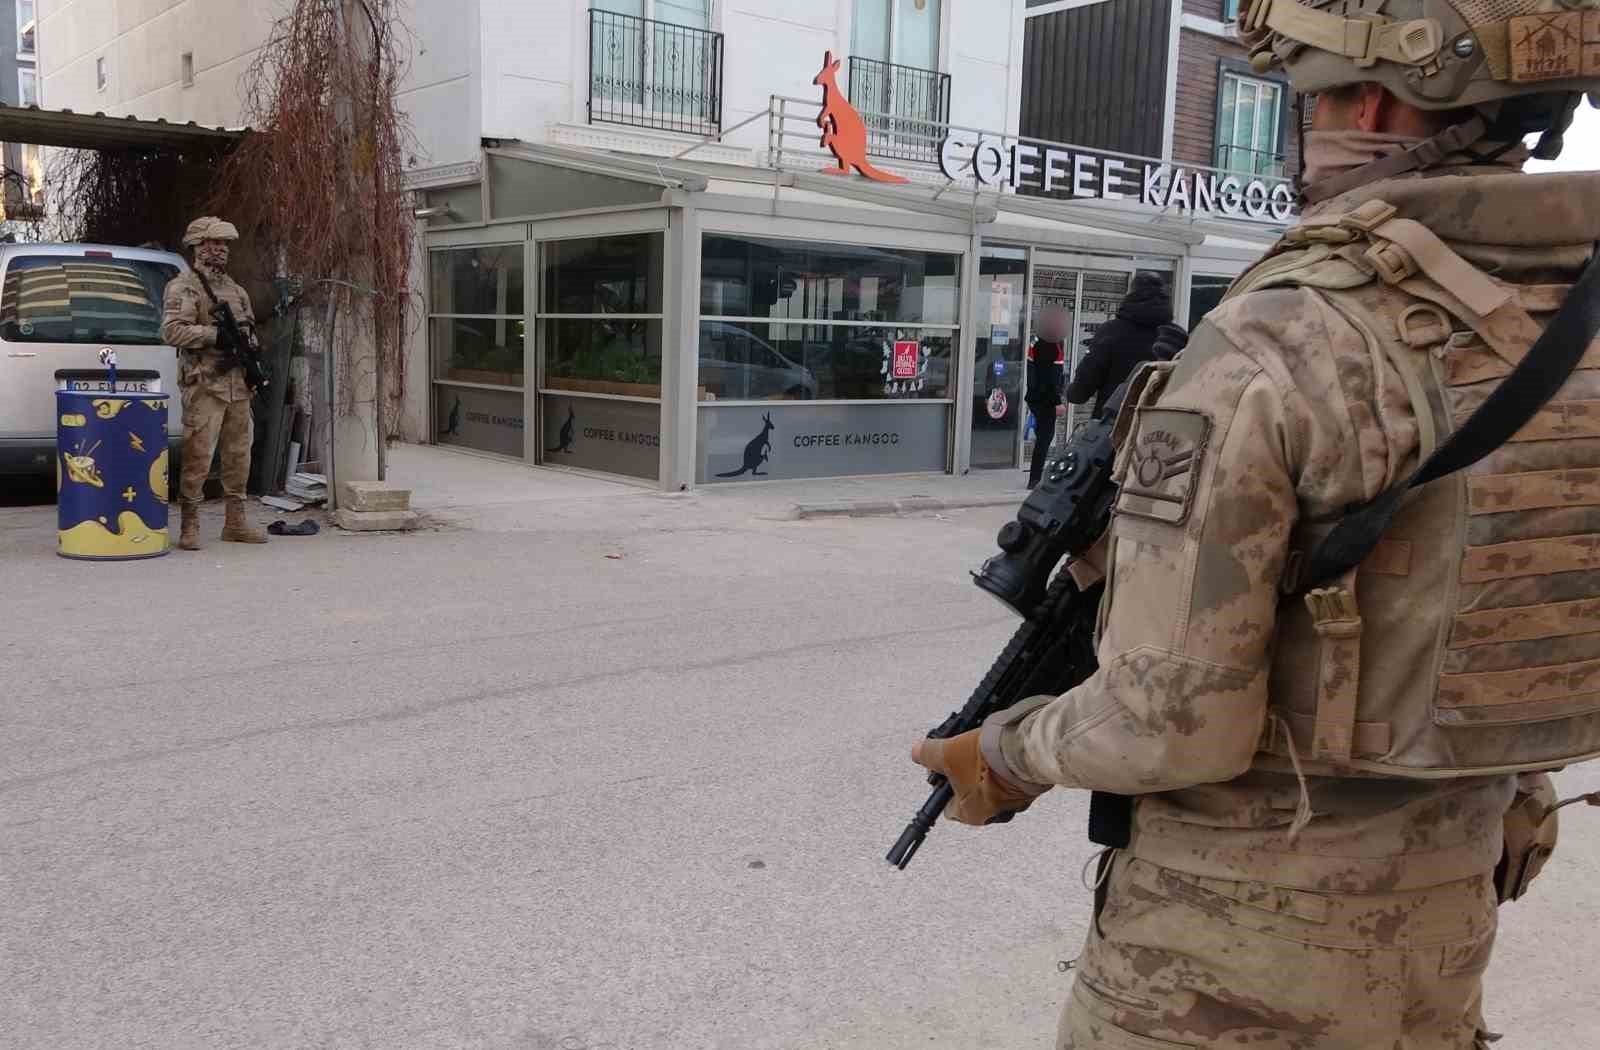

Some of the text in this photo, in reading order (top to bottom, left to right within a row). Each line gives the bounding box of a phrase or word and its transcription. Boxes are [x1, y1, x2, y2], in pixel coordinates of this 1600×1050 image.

[939, 134, 1293, 220] COFFEE KANGOO
[465, 411, 490, 425] COFFEE
[583, 427, 660, 446] COFFEE KANGOO
[793, 432, 899, 448] COFFEE KANGOO
